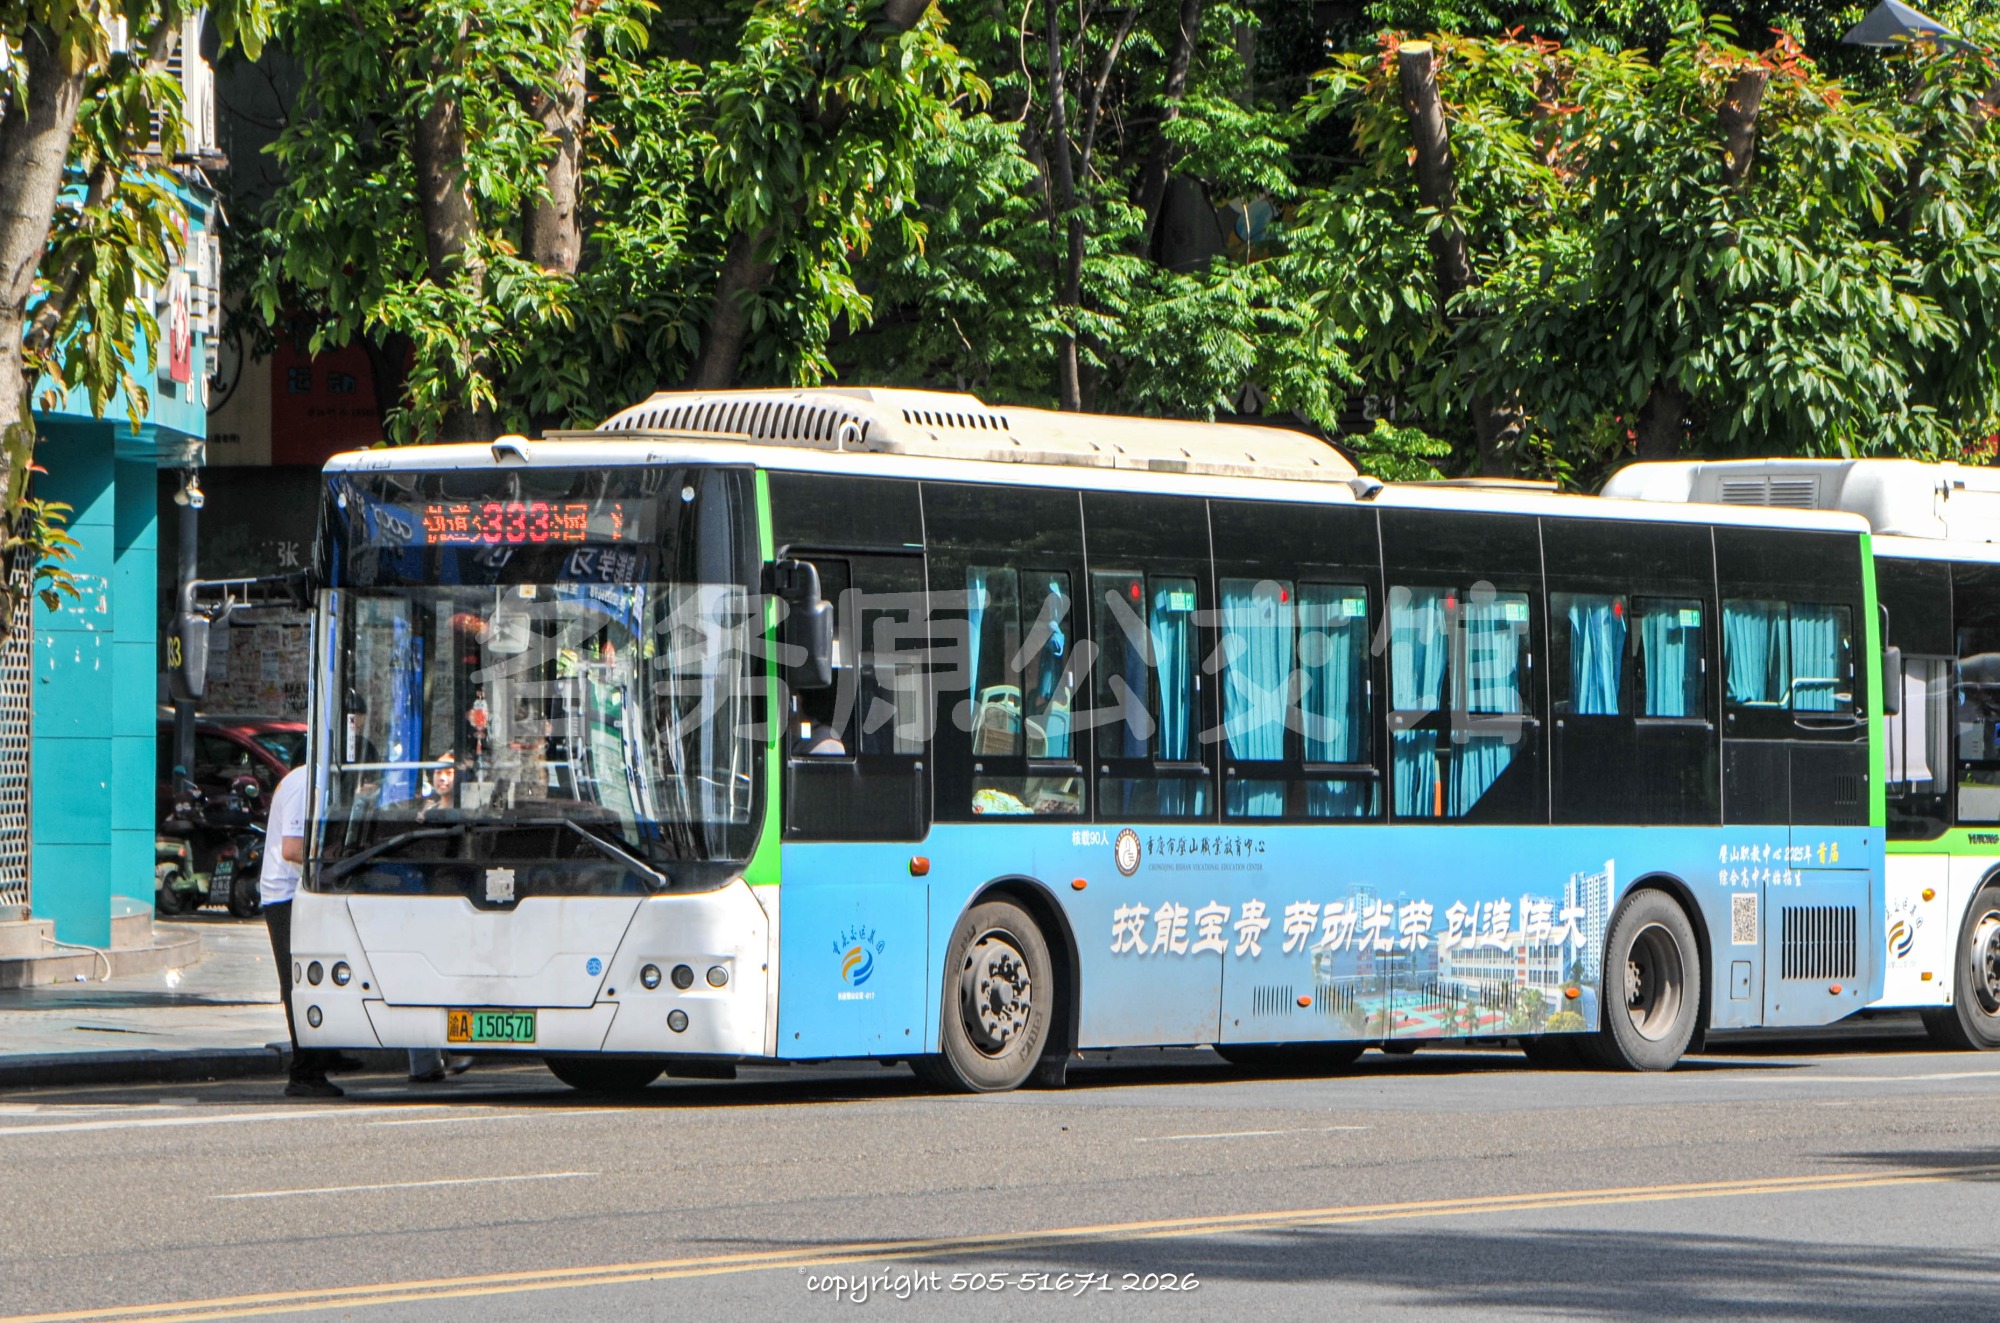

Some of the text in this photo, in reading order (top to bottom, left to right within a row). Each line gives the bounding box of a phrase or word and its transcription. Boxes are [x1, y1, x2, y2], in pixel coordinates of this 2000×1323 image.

[1110, 897, 1588, 958] 技能宝贵 劳动光荣 创造伟大
